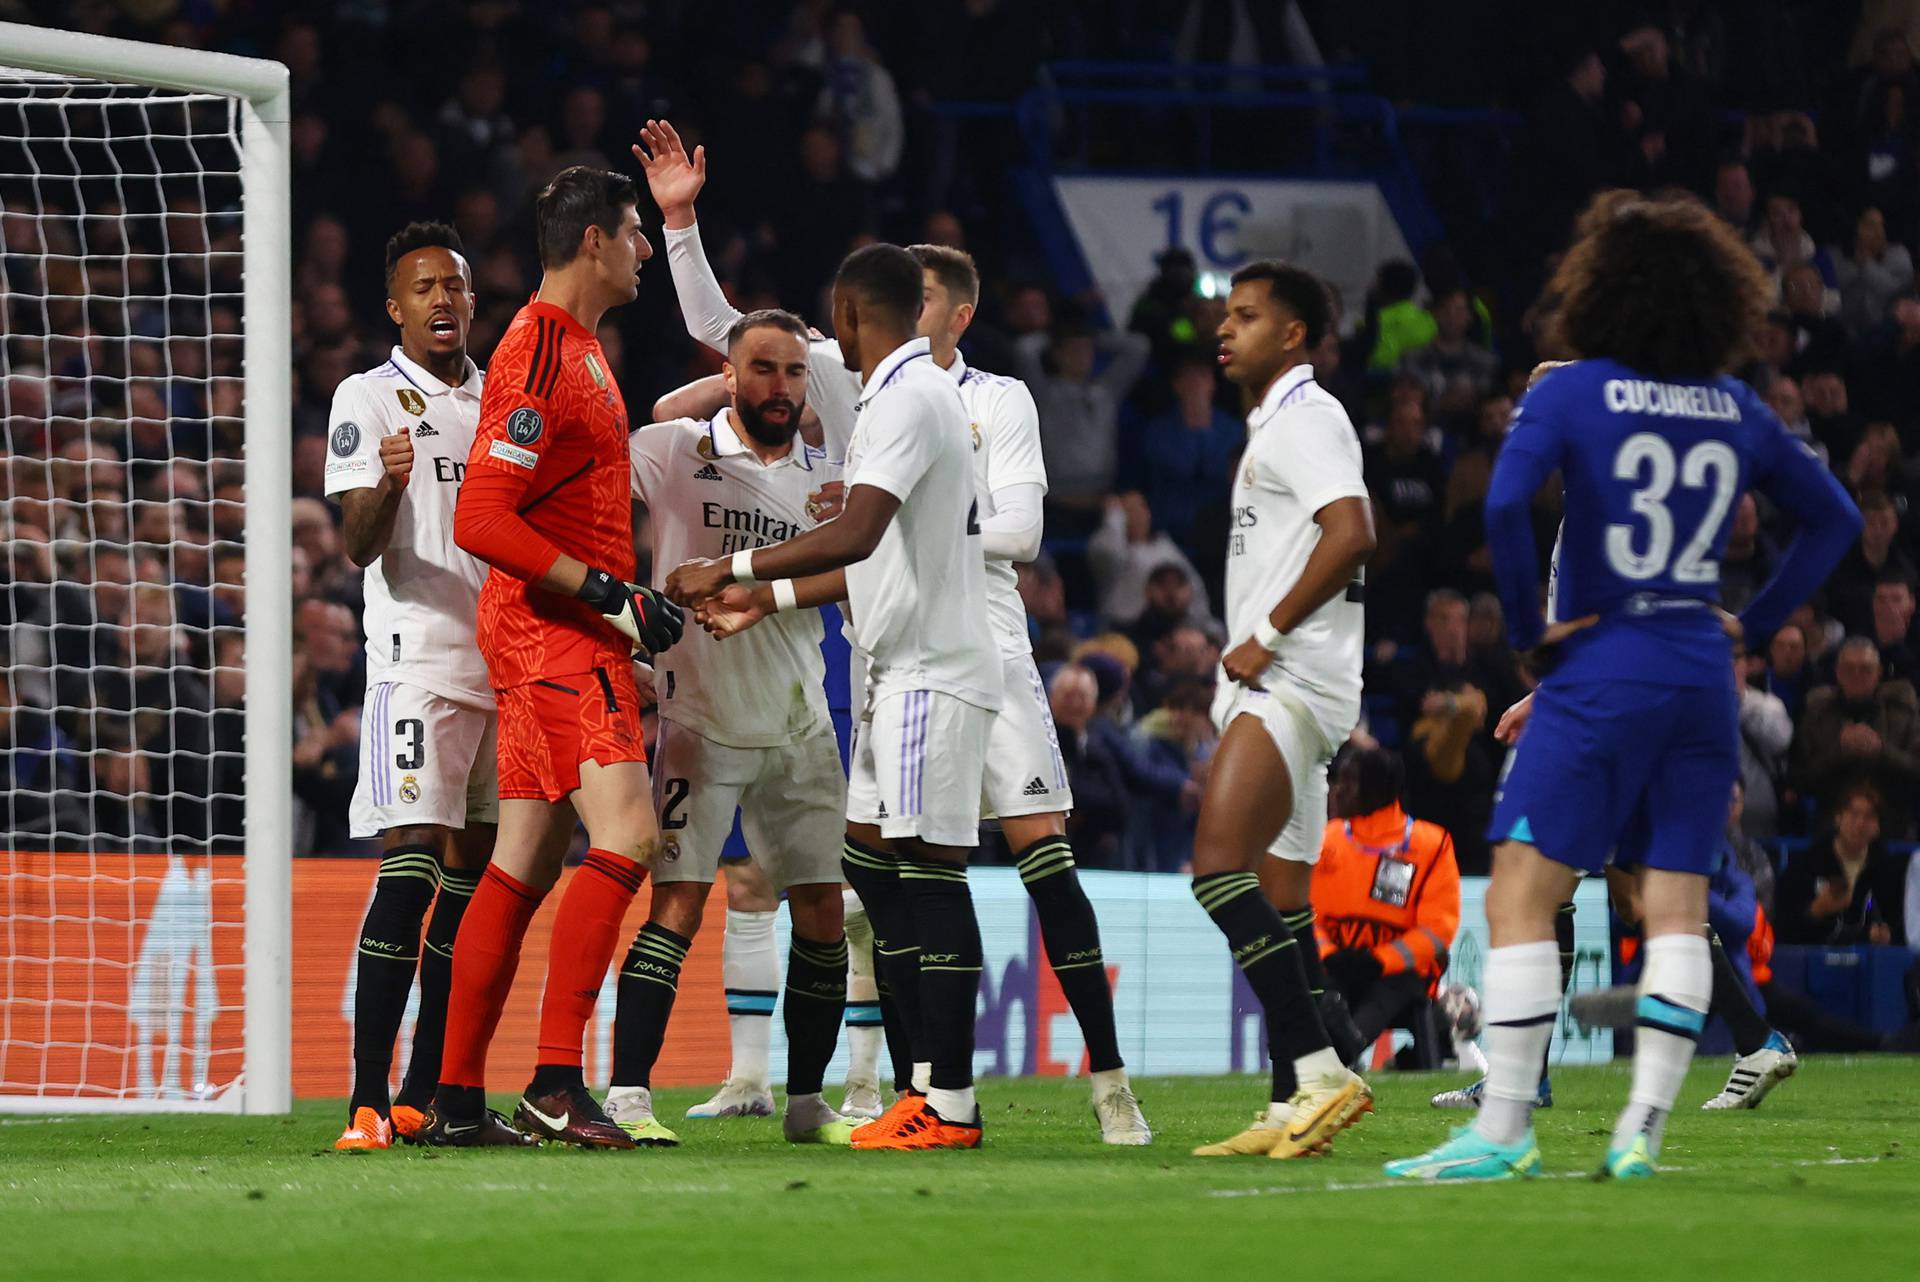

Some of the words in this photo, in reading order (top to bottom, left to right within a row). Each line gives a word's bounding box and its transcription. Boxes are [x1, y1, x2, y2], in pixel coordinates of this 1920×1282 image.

[1604, 379, 1742, 422] CUCURELLA
[415, 430, 440, 438] adidas
[518, 424, 529, 436] 14
[340, 438, 350, 448] 14
[492, 444, 536, 465] FOUNDATION
[693, 472, 723, 481] adidas
[1605, 431, 1740, 583] 32
[702, 502, 801, 541] Emirat
[395, 718, 424, 770] 3
[1023, 788, 1049, 796] adidas
[661, 777, 689, 830] 2
